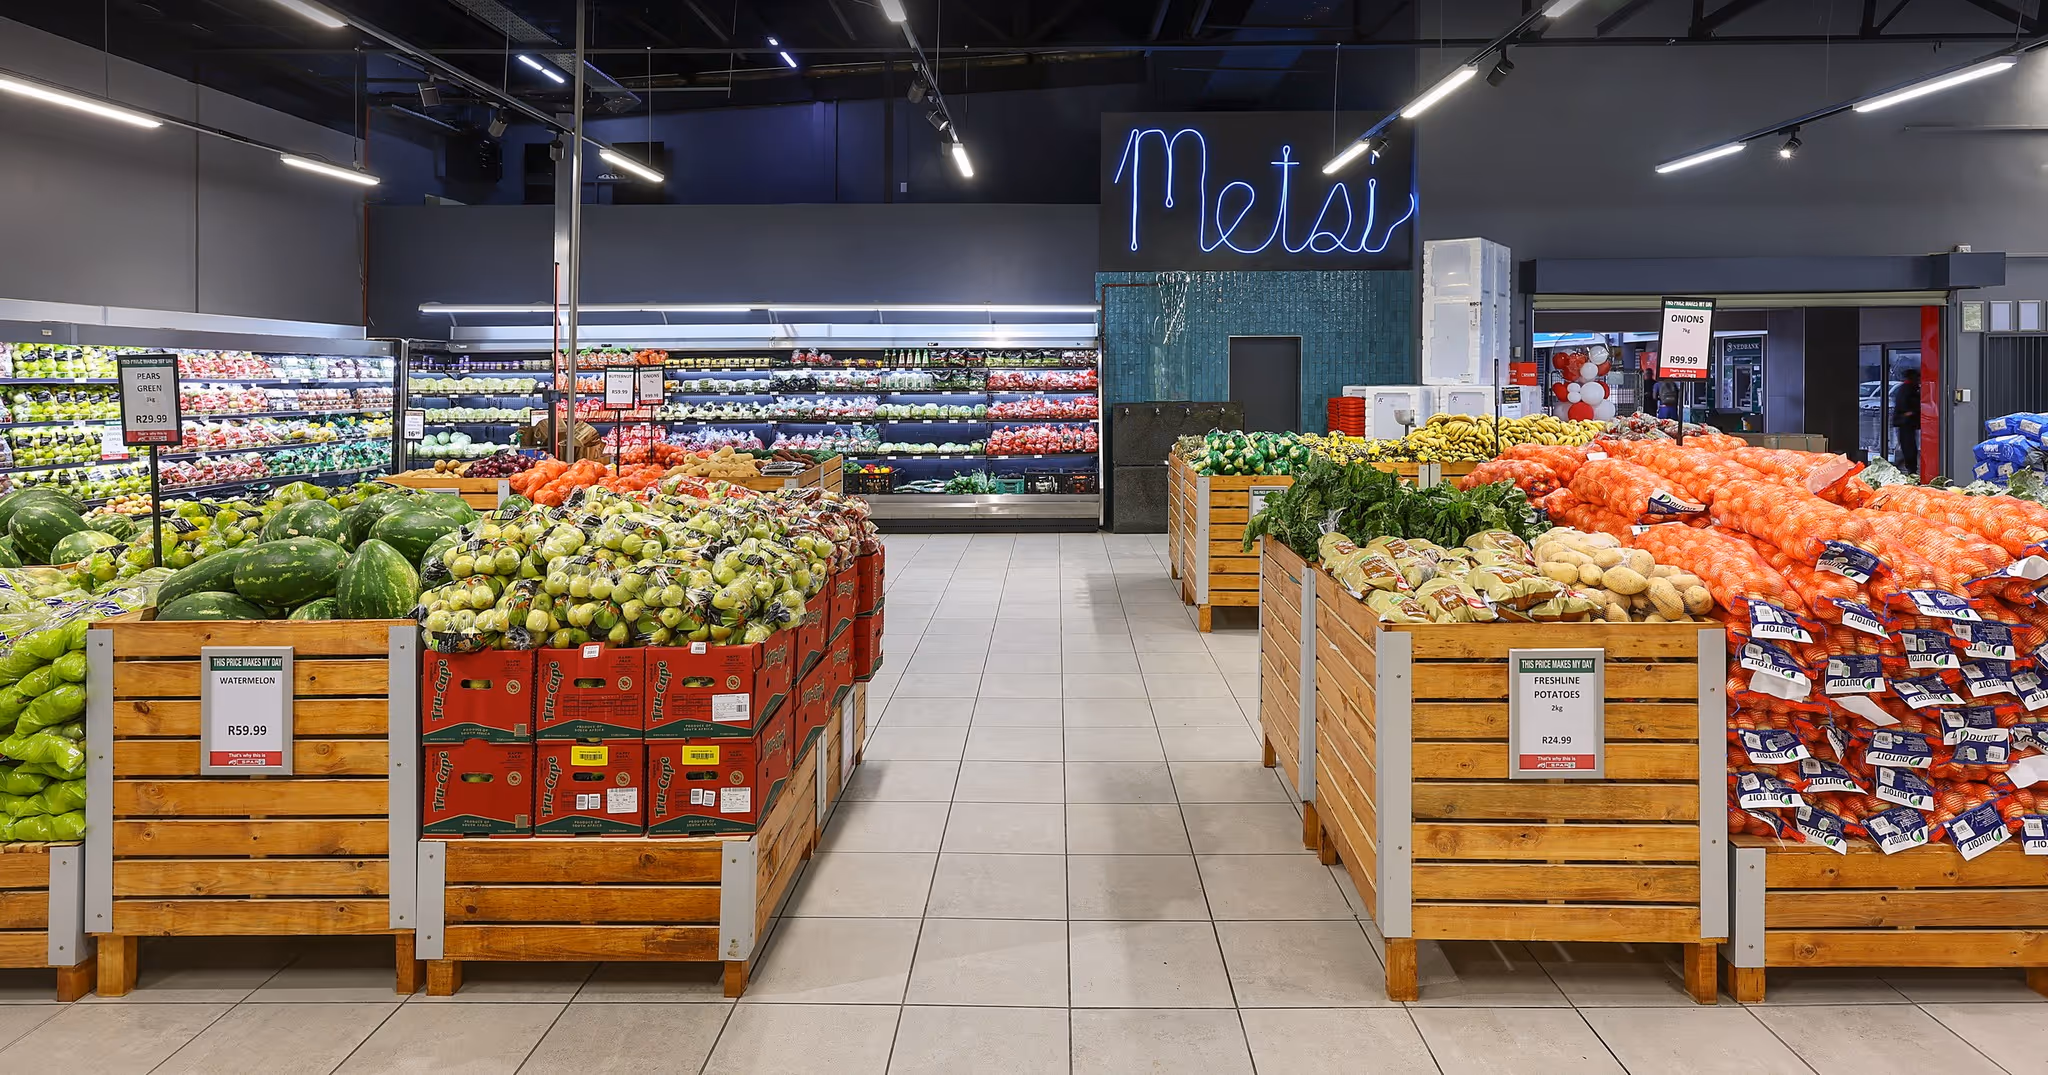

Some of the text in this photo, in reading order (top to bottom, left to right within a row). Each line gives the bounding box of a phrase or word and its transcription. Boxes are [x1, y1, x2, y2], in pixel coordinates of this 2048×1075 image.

[1113, 128, 1416, 254] Metsi
[1671, 314, 1704, 324] ONIONS
[1669, 355, 1698, 364] R99.99
[137, 372, 161, 380] PEARS
[137, 384, 162, 393] GREEN
[135, 414, 168, 424] R29.99
[1850, 613, 1877, 628] DUTOIT
[1761, 624, 1791, 634] DUTOIT
[213, 657, 282, 667] THIS PRICE MAKES MY DAY
[1521, 660, 1593, 669] THIS PRICE MAKES MY DAY
[1750, 659, 1781, 672] DUTOIT
[219, 677, 276, 685] WATERMELON
[1534, 676, 1580, 685] FRESHLINE
[1833, 679, 1861, 687] DUTOIT
[430, 659, 453, 721] Tru-Cape
[542, 660, 564, 722] Tru-Cape
[651, 660, 673, 722] Tru-Cape
[1534, 690, 1580, 699] POTATOES
[1914, 692, 1941, 703] DUTOIT
[1551, 704, 1563, 712] 2kg
[228, 725, 268, 736] R59.99
[1541, 736, 1572, 744] R24.99
[1757, 752, 1783, 760] DUTOIT
[1876, 752, 1909, 763] DUTOIT
[432, 750, 454, 812] Tru-Cape
[541, 756, 563, 817] Tru-Cape
[655, 756, 676, 818] Tru-Cape
[1749, 793, 1779, 801] DUTOIT
[1884, 786, 1908, 800] DUTOIT
[1888, 833, 1910, 846] DUTOIT
[1967, 833, 1992, 851] DUTOIT
